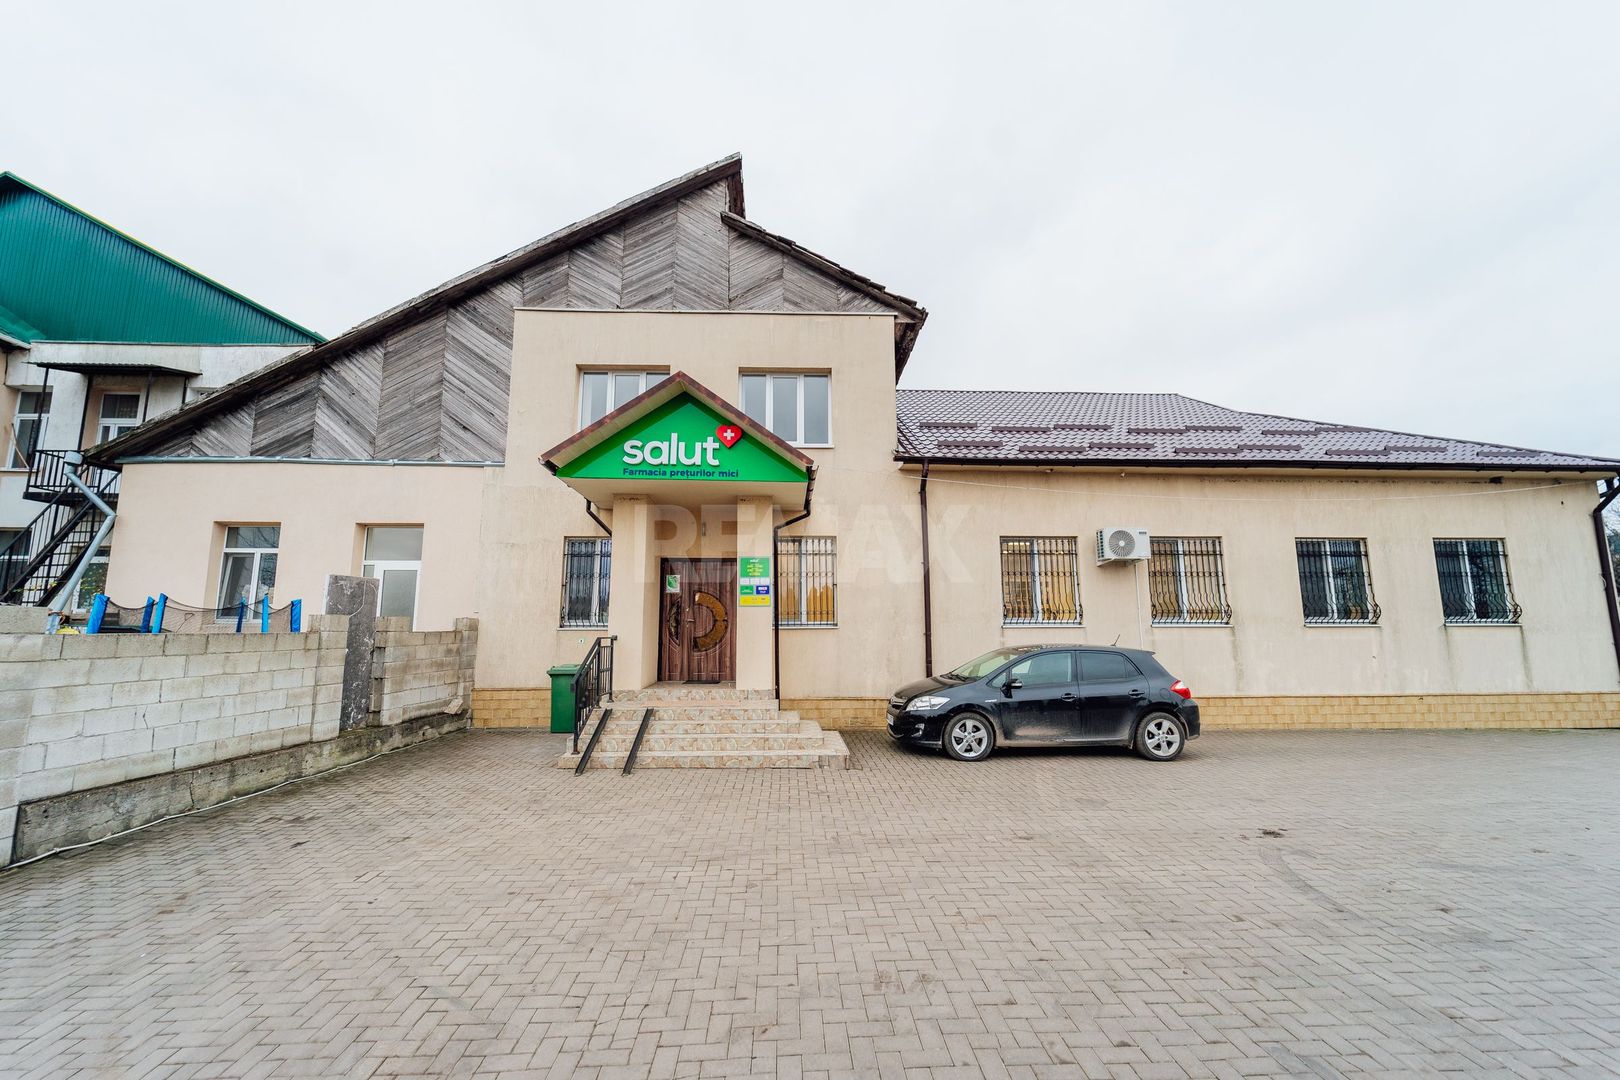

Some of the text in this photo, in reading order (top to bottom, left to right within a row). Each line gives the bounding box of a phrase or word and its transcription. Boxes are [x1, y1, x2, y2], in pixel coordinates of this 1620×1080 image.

[622, 432, 720, 466] salut
[623, 468, 667, 477] Farmacia
[718, 469, 739, 478] mici
